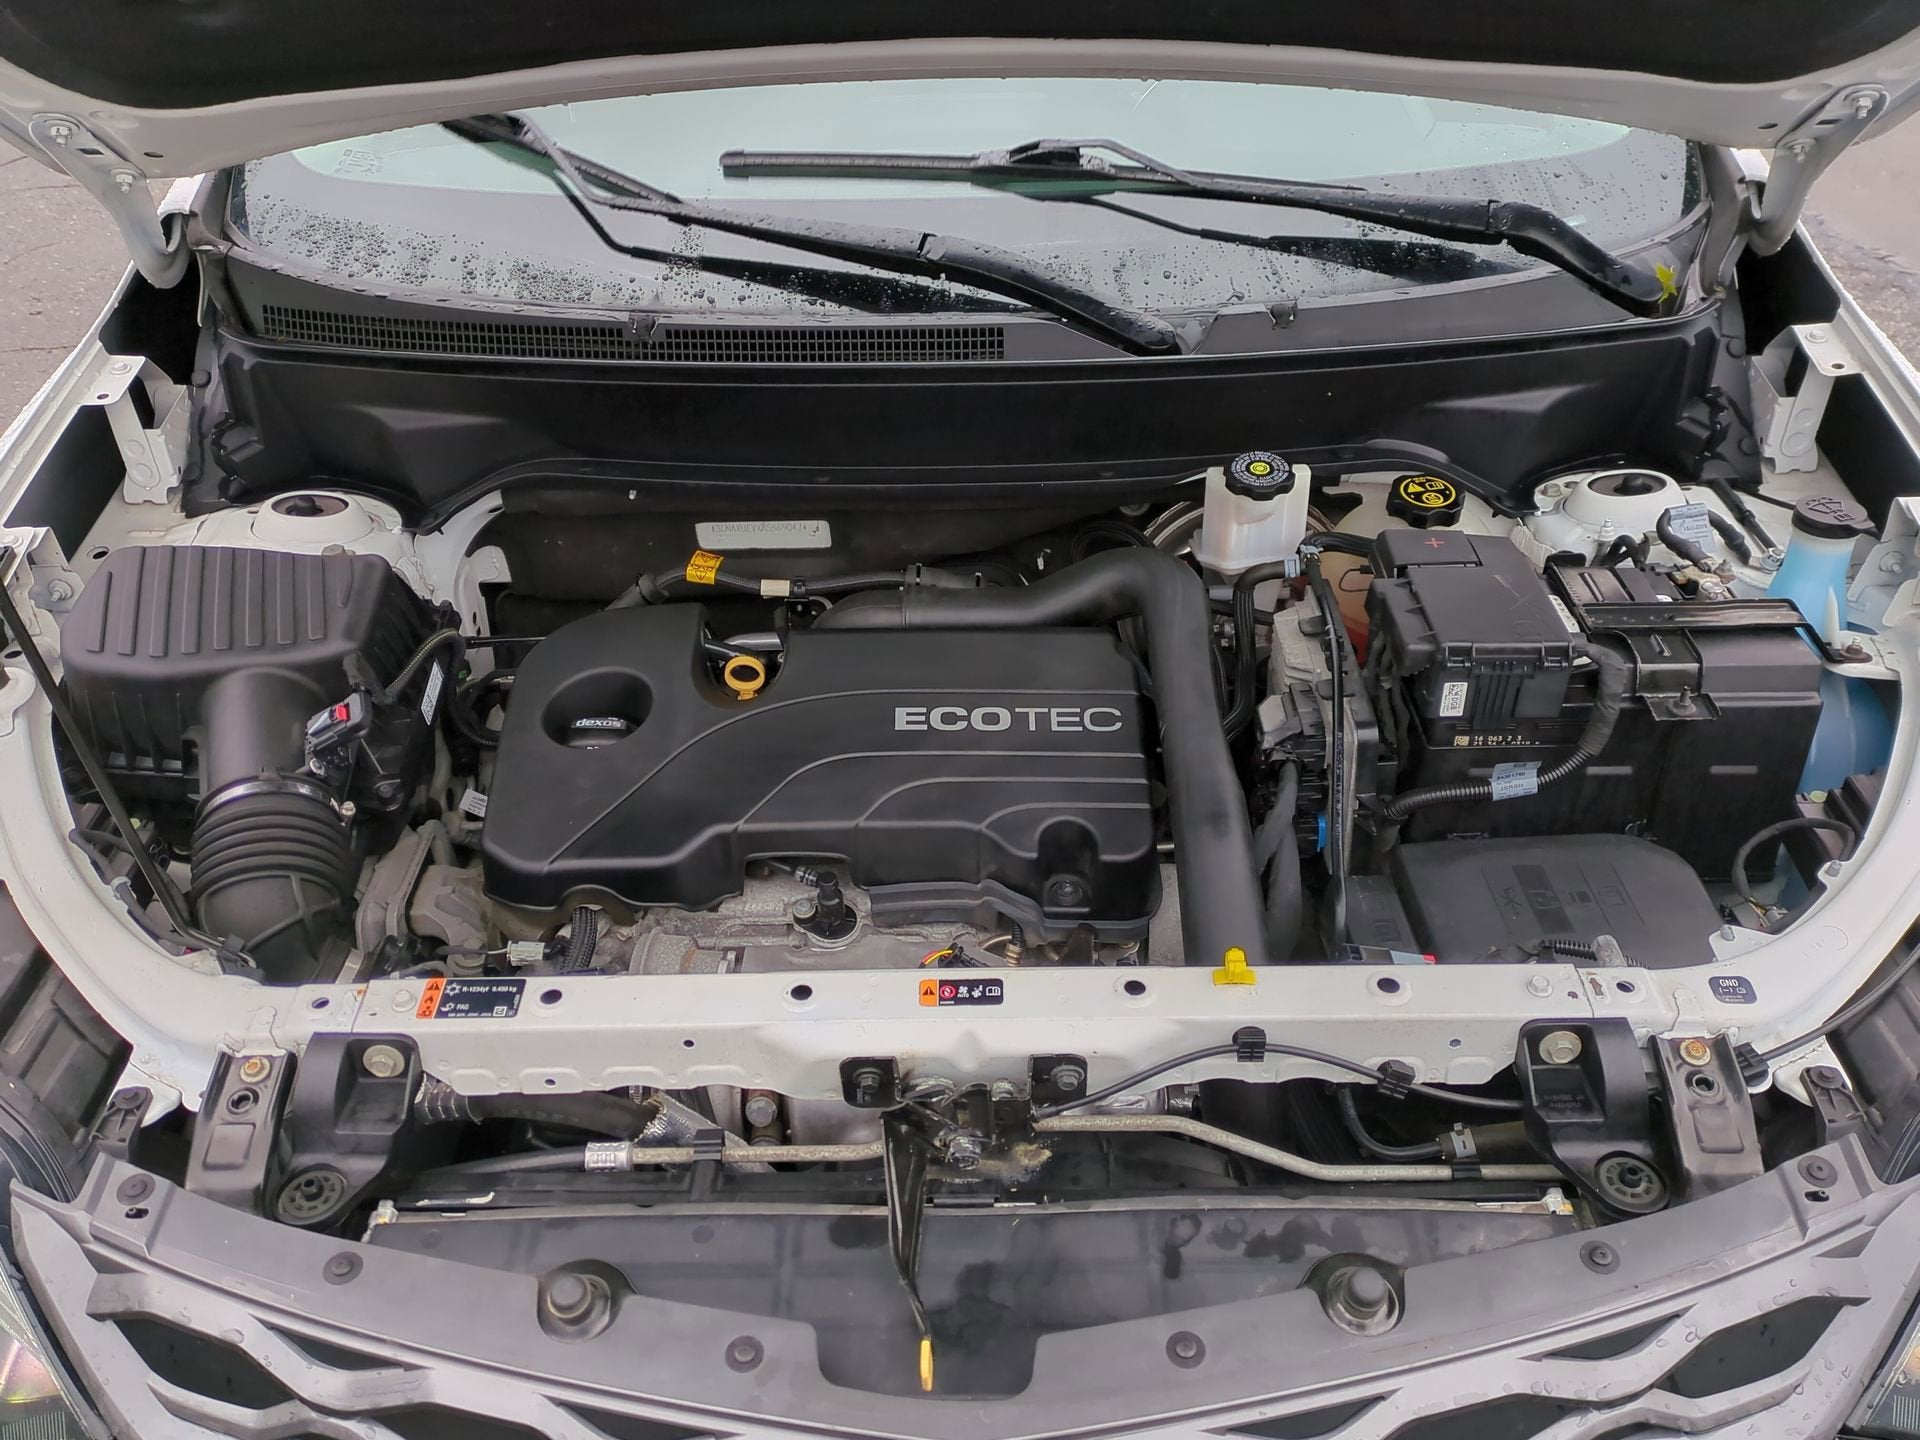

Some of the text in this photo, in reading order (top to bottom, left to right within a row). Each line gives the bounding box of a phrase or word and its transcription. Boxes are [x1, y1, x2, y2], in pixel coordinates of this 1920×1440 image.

[576, 718, 621, 727] dexos
[894, 706, 1123, 731] ECOTEC
[1719, 979, 1739, 987] GND
[462, 986, 490, 994] R-1234yf
